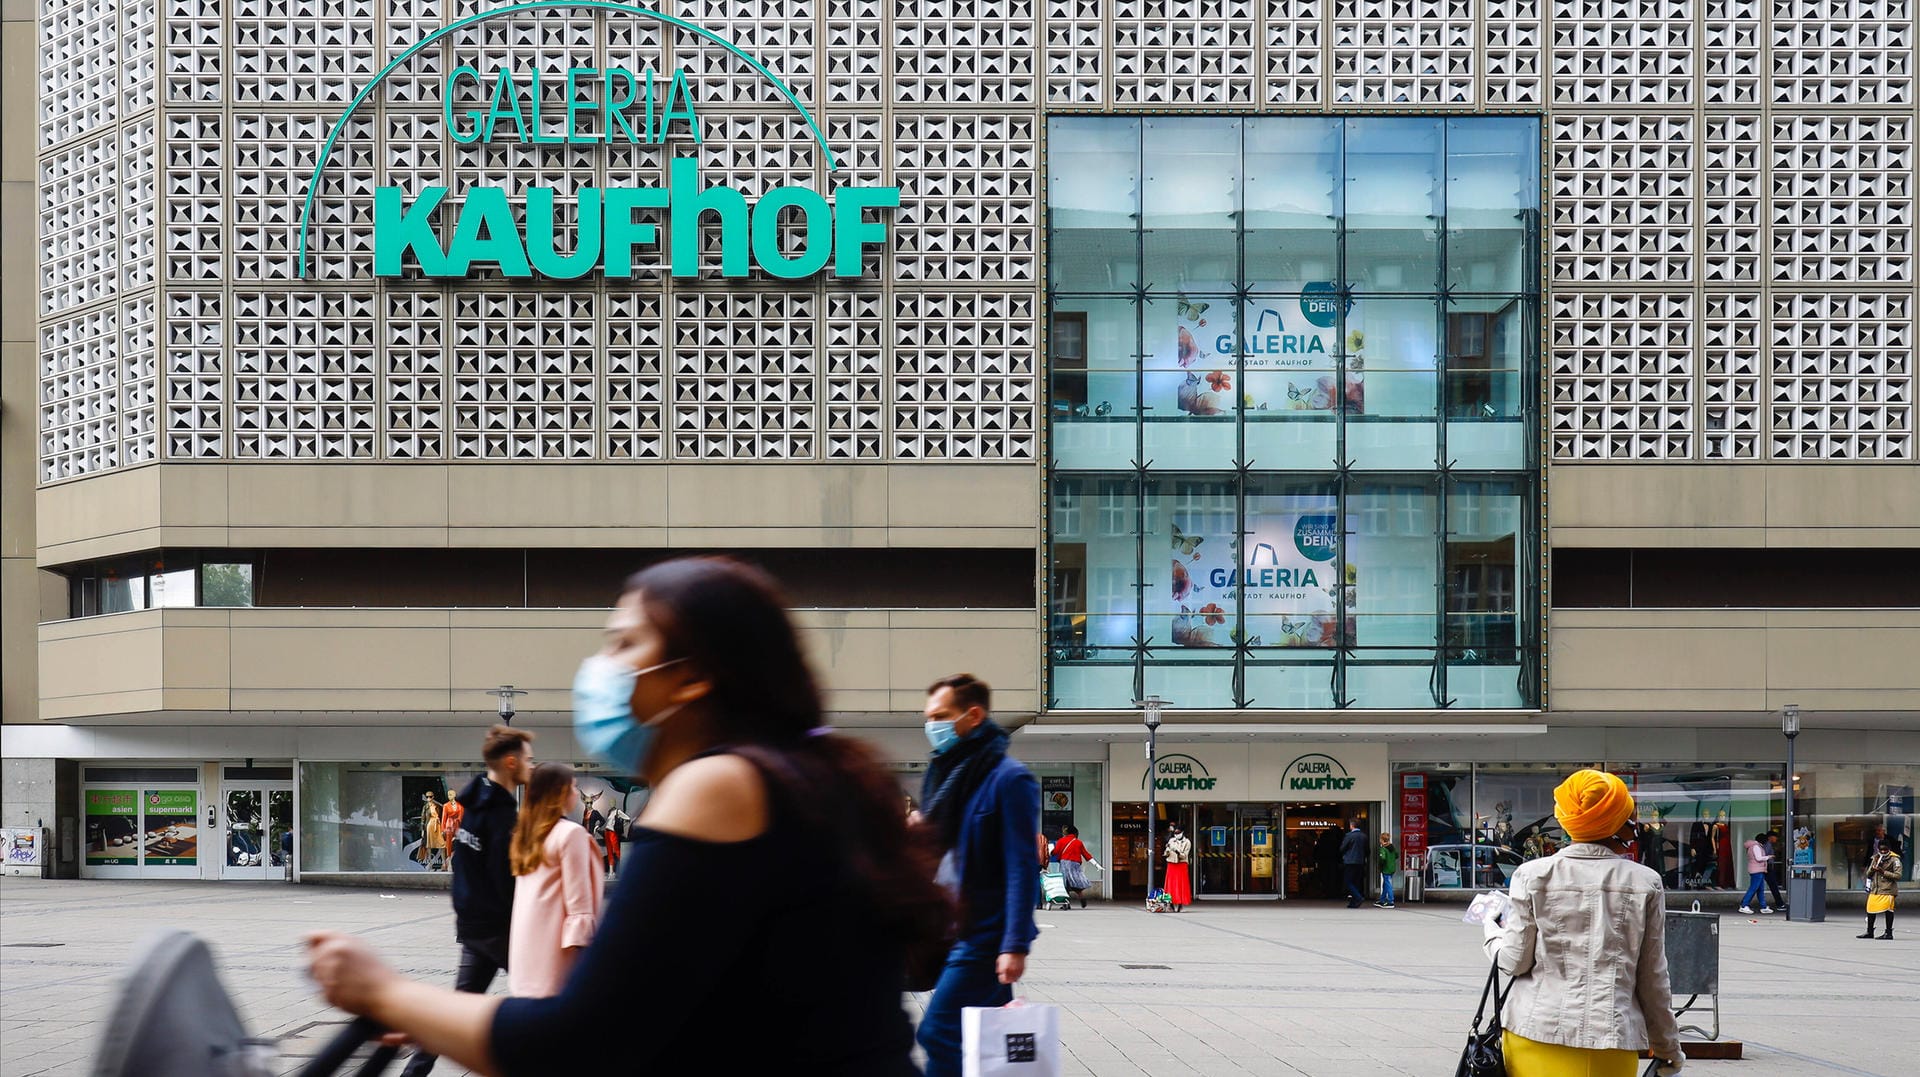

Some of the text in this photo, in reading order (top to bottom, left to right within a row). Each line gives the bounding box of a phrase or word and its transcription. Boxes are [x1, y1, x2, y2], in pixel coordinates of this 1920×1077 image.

[445, 66, 703, 145] GALERIA
[1309, 301, 1349, 313] DEIN
[1275, 359, 1313, 367] KAUFHOF
[1269, 592, 1308, 600] KAUFHOF
[1158, 762, 1193, 774] GALERIA
[1297, 762, 1331, 774] GALERIA
[149, 806, 193, 814] supermarkt
